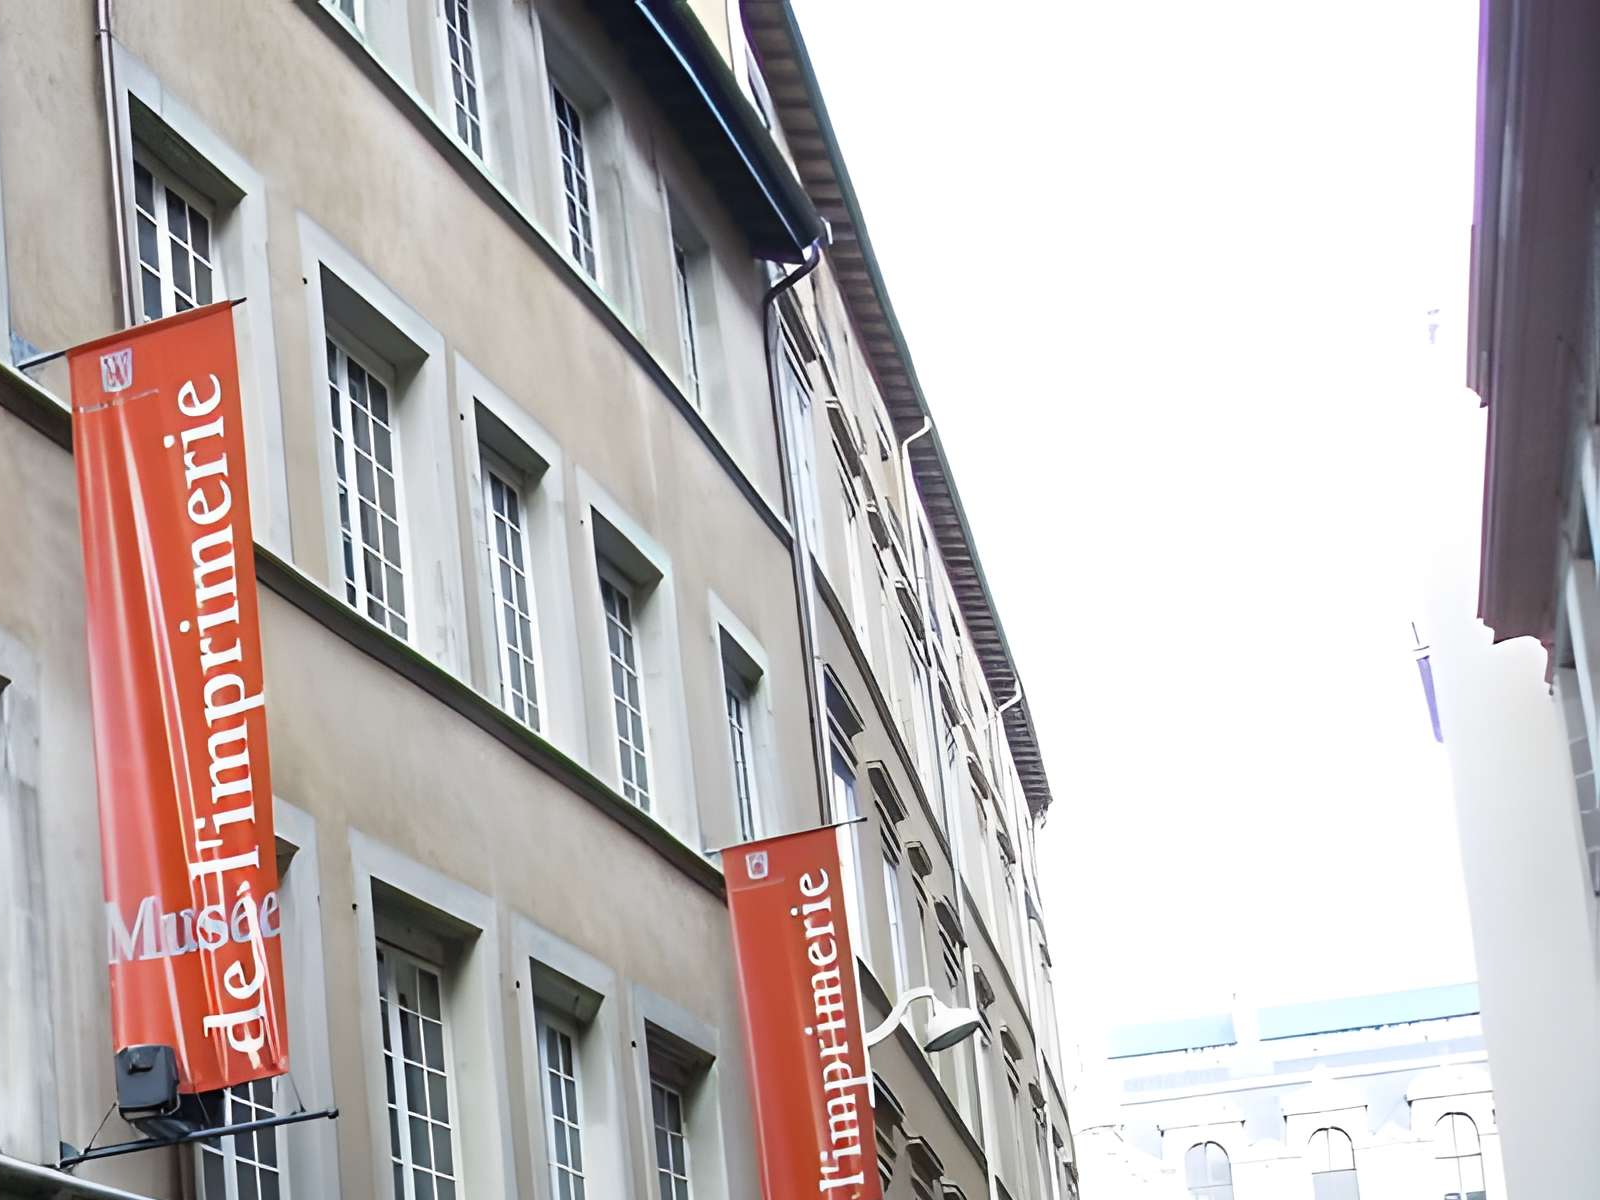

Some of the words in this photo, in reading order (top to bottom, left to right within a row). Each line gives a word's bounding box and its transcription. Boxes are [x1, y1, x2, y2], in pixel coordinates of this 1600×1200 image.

[163, 373, 265, 881] l'imprimerie
[106, 880, 280, 964] Musée
[204, 957, 266, 1057] de
[790, 868, 866, 1192] l'imprimerie
